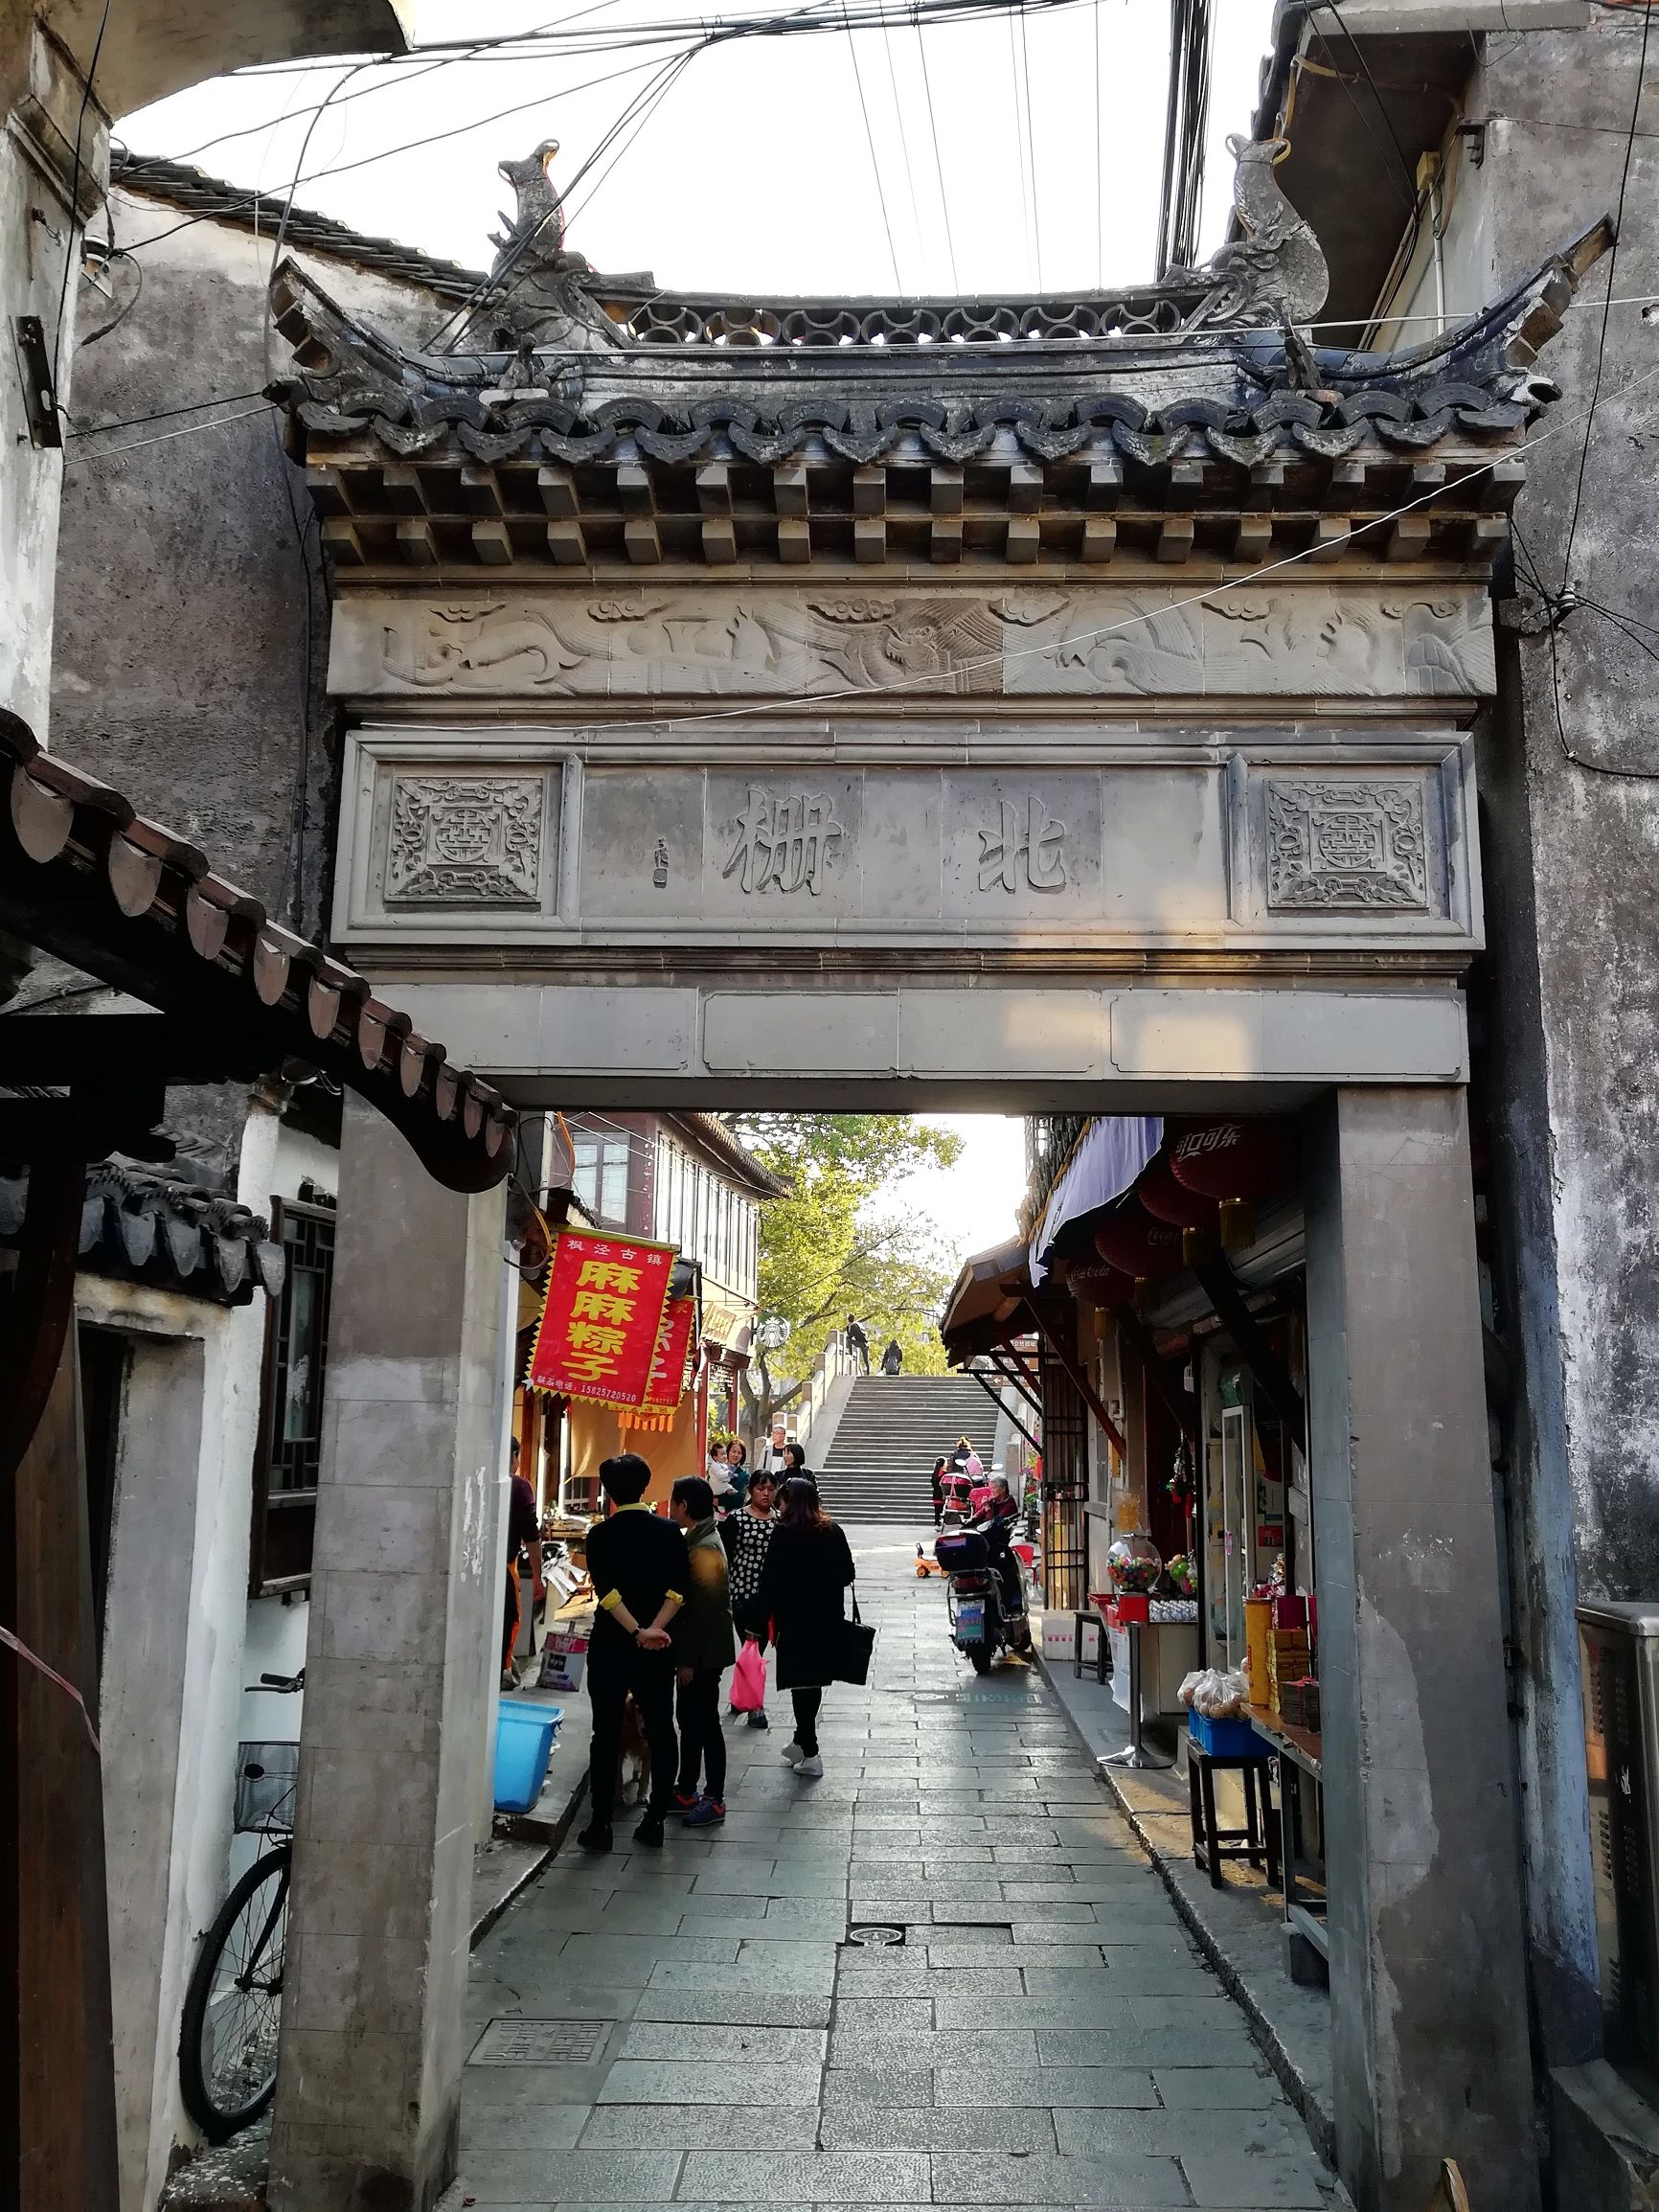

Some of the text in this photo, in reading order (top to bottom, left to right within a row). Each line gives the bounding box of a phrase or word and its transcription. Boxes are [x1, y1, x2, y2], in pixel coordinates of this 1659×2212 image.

[1175, 1123, 1245, 1161] 可口可乐
[567, 1239, 663, 1266] 枫泾古镇
[561, 1260, 643, 1382] 麻麻粽子
